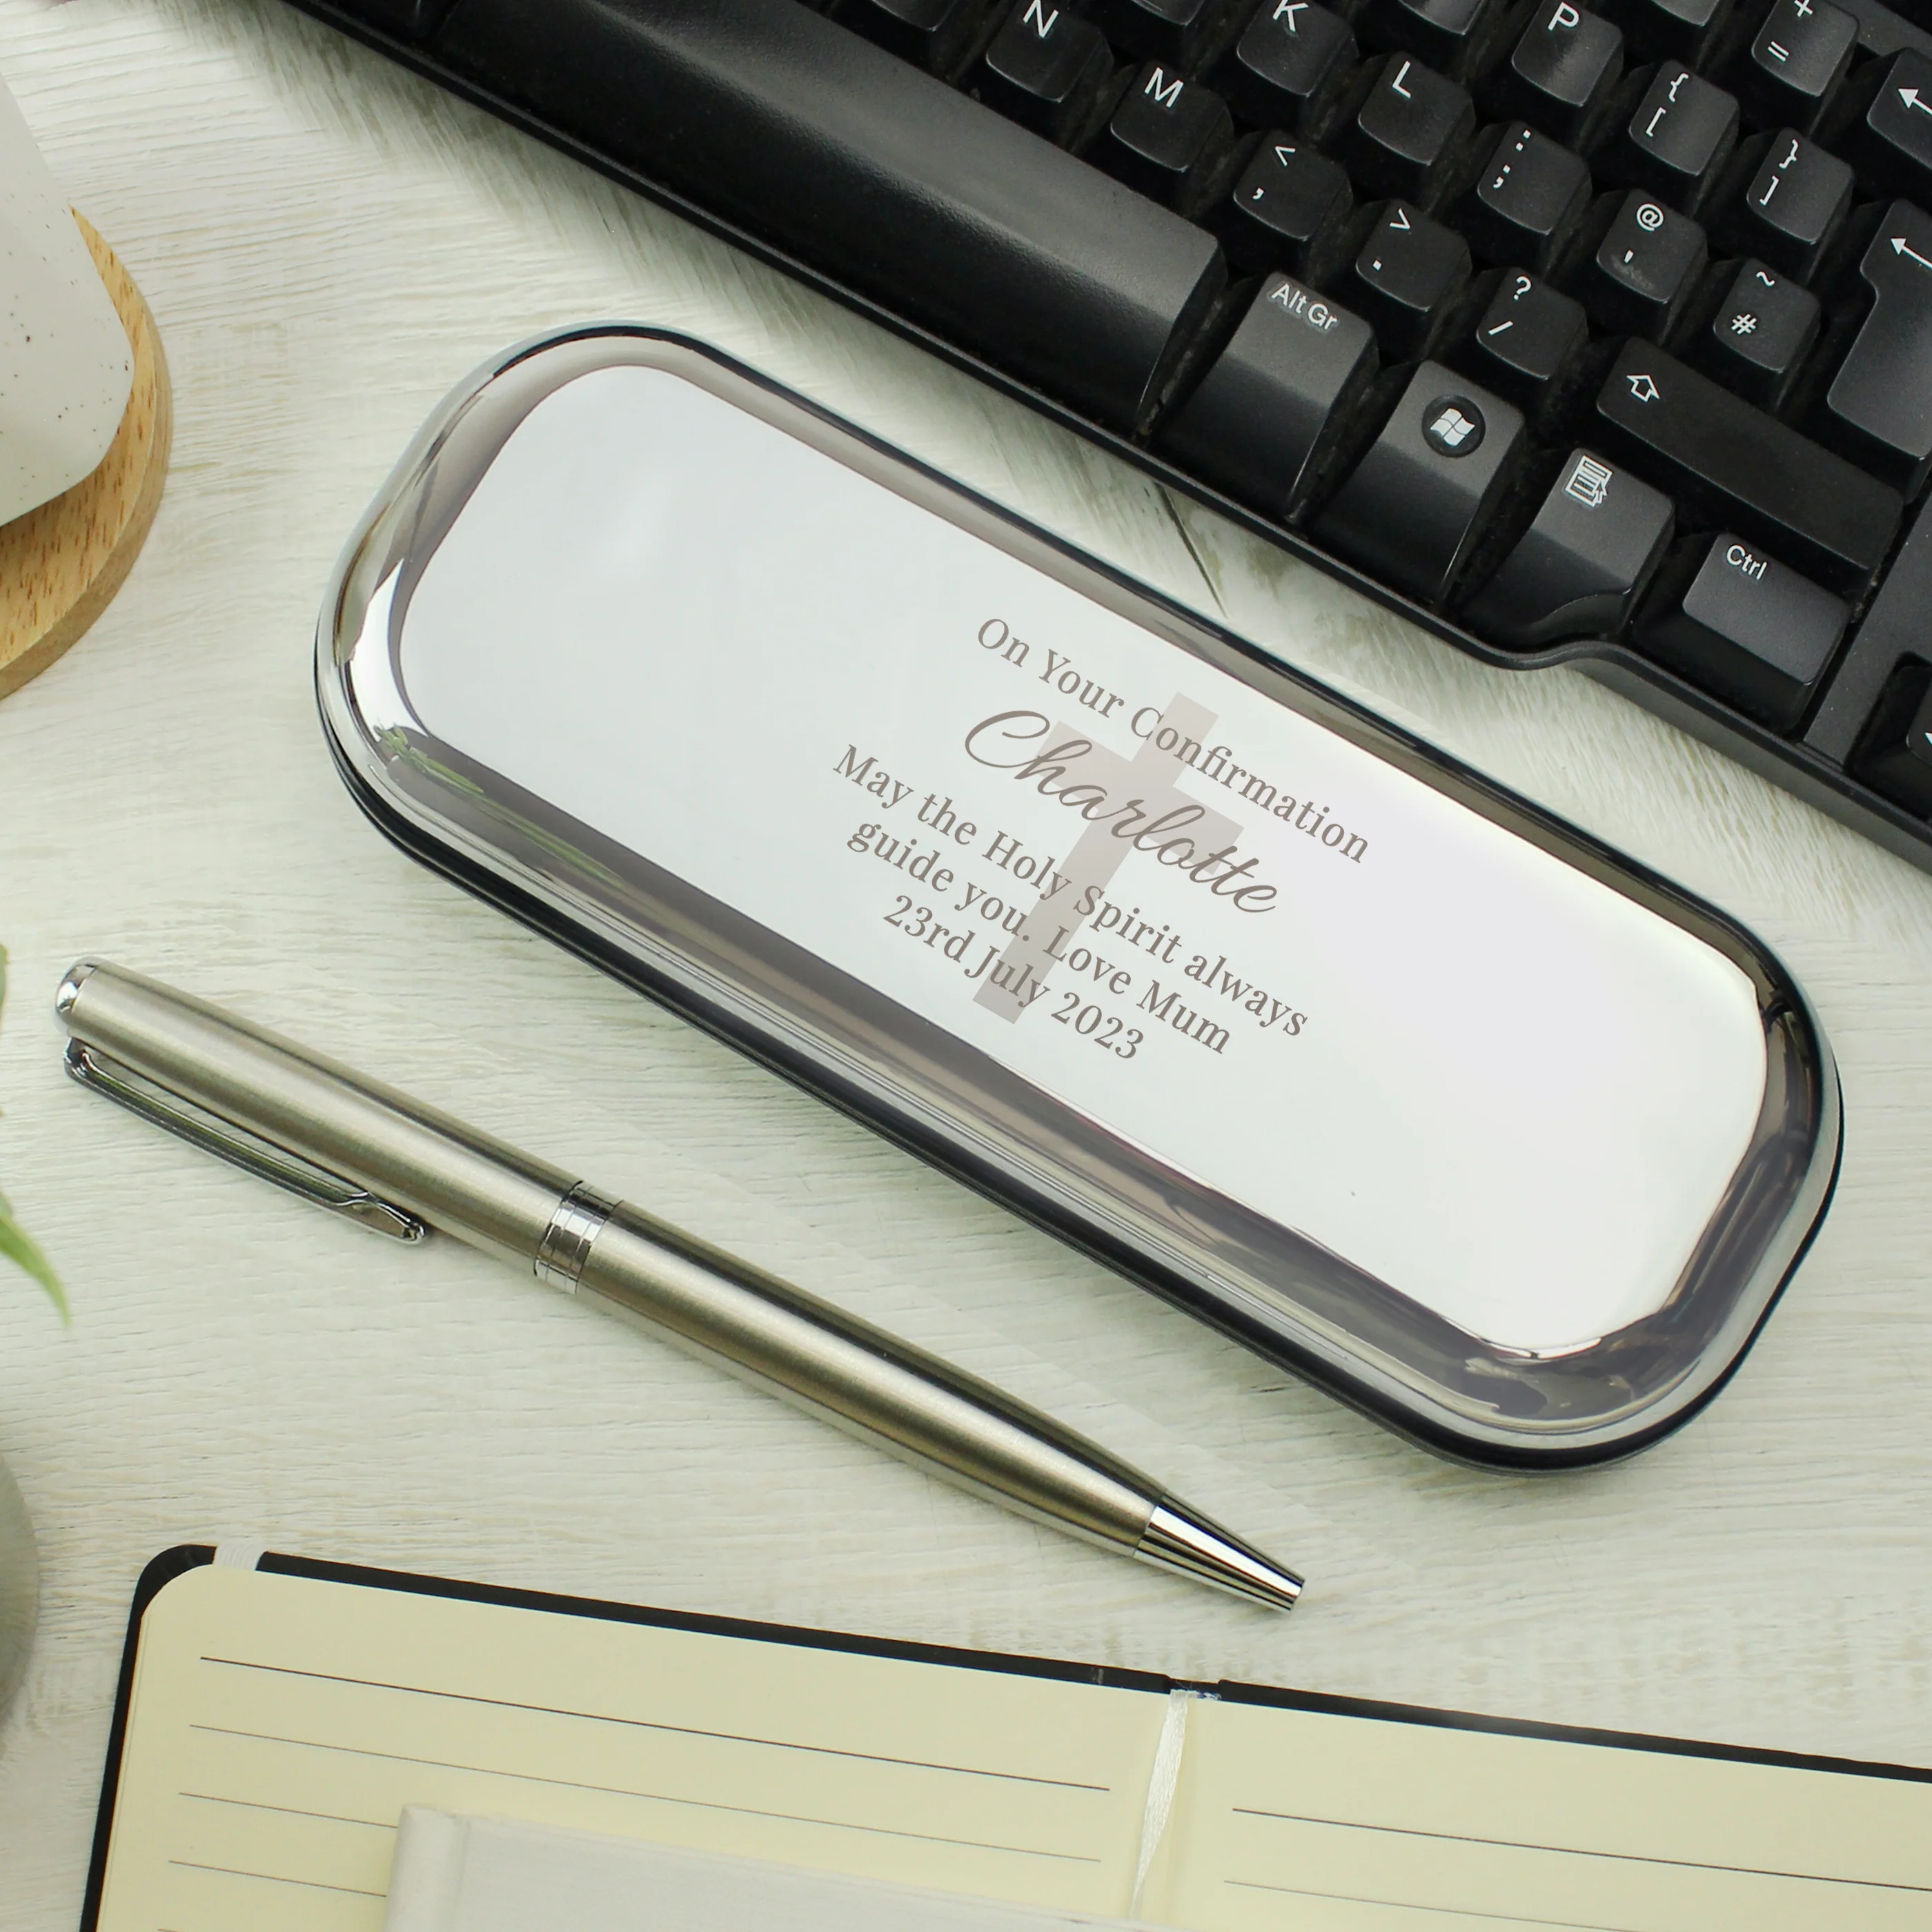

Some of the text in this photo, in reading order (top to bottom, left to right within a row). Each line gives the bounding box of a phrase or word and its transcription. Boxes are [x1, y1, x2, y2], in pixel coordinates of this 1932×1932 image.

[1023, 0, 1058, 38] N
[1272, 0, 1308, 32] K
[1548, 2, 1579, 30] P
[1145, 67, 1183, 108] M
[1392, 61, 1411, 98] L
[1637, 204, 1664, 231] @
[1270, 283, 1338, 331] Alt Gr
[1726, 544, 1768, 580] Ctrl
[978, 618, 1369, 863] On Your Confirmation
[965, 710, 1277, 913] Charlotte
[833, 744, 1308, 1036] May the Holy Spirit always
[847, 823, 1232, 1054] guide you. Love Mum
[883, 895, 1144, 1059] 23rd July 2023
